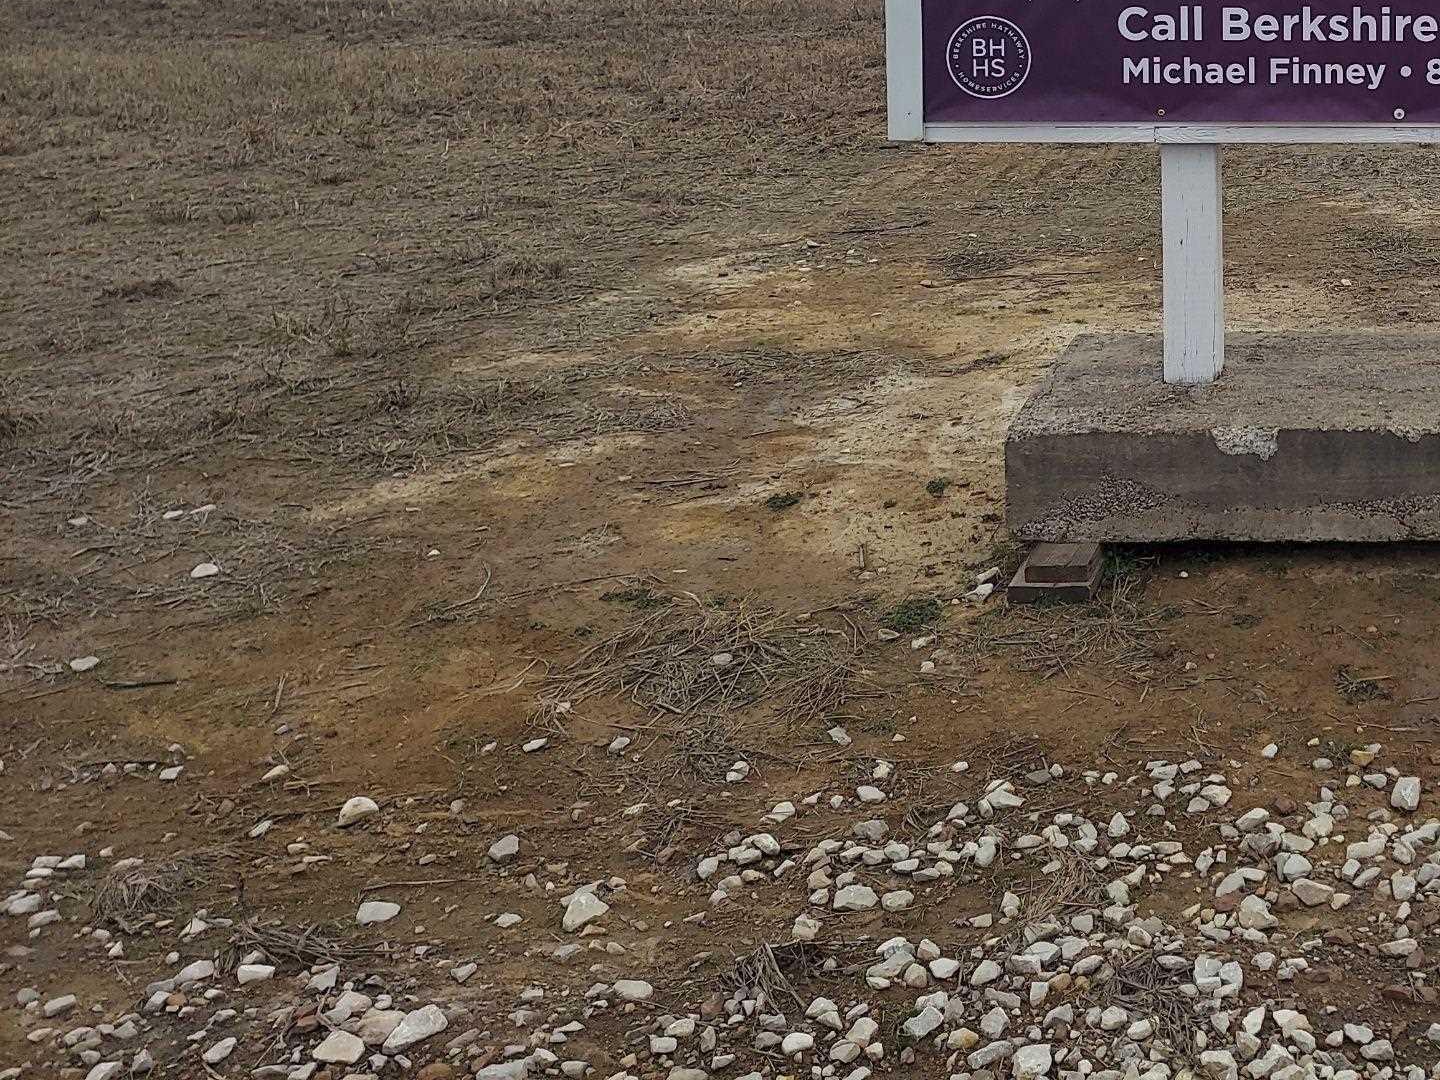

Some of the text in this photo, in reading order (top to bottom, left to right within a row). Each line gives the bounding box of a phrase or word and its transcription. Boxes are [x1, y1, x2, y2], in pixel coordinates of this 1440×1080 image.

[1117, 5, 1203, 42] Call
[1222, 6, 1439, 43] Berkshire
[952, 22, 1025, 60] BERKSHIRE HATHAWAY
[972, 38, 1005, 57] BH
[957, 71, 1021, 93] HOMESERVICES
[972, 58, 1005, 78] HS
[1122, 56, 1256, 85] Michael
[1269, 57, 1386, 90] Finney
